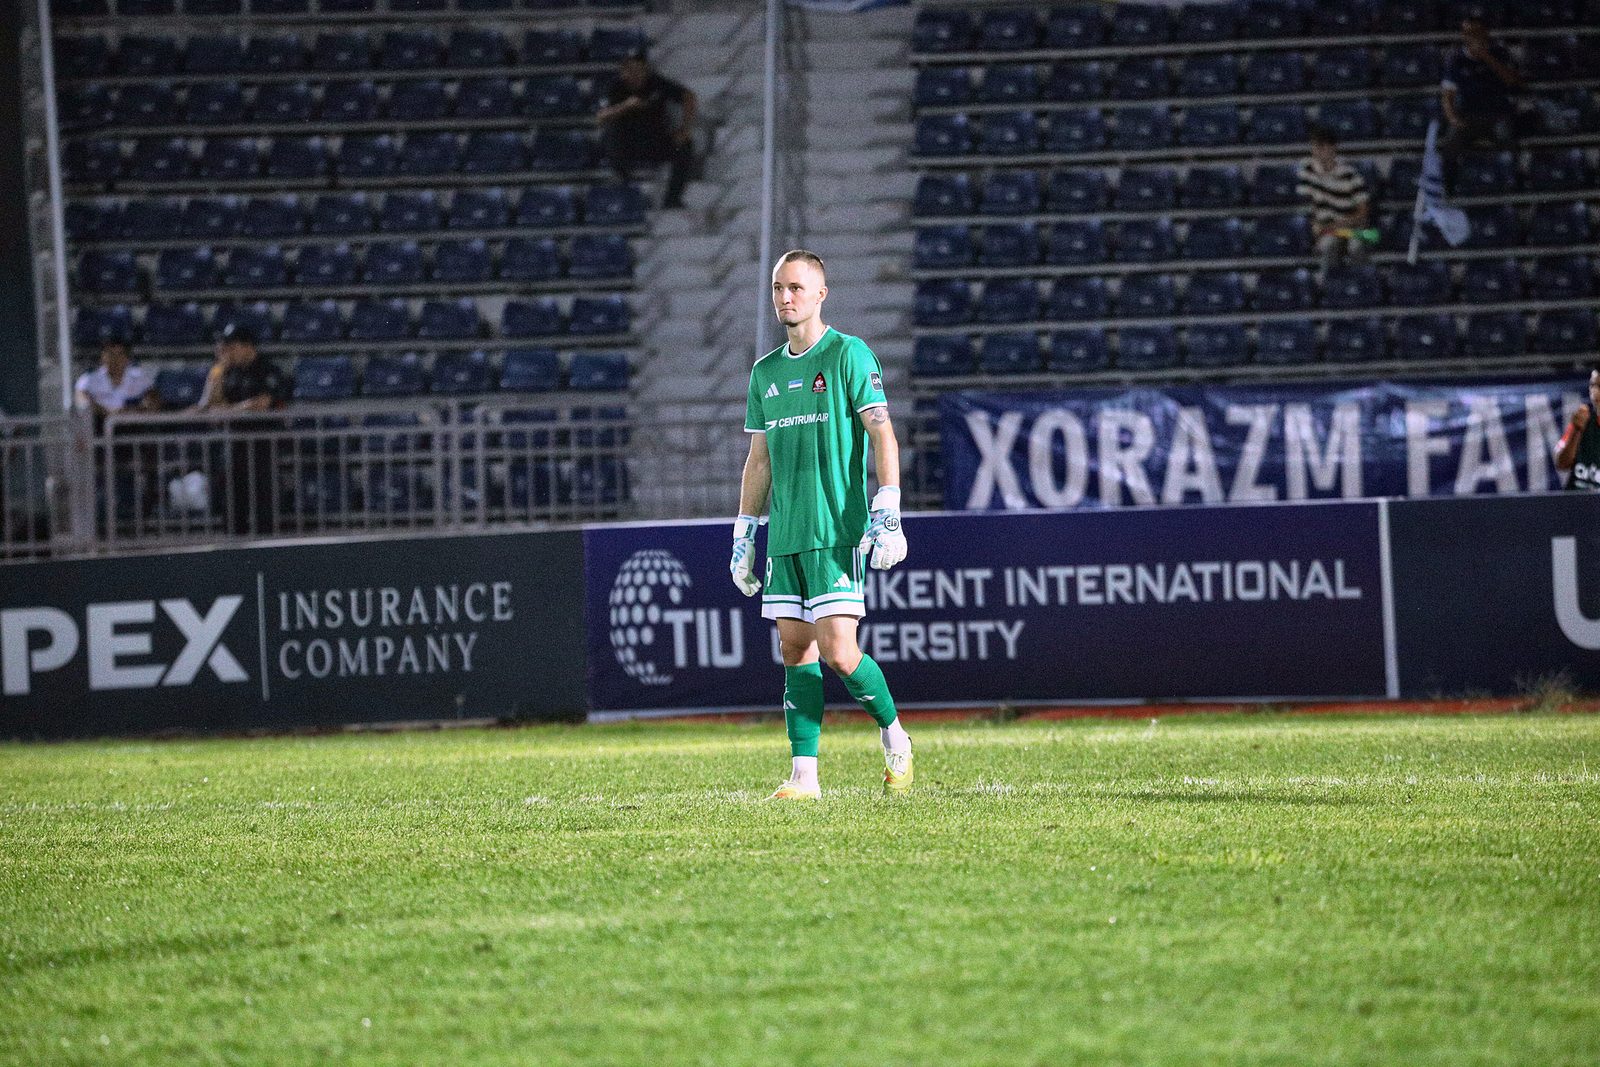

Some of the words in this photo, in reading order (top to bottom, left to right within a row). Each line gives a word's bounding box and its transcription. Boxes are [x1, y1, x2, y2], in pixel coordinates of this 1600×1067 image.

[966, 401, 1363, 510] XORAZM
[279, 581, 513, 631] INSURANCE
[864, 568, 993, 609] HKENT
[1004, 558, 1362, 607] INTERNATIONAL
[0, 595, 249, 695] PEX
[279, 632, 479, 680] COMPANY
[662, 608, 744, 668] TIU
[771, 620, 1024, 664] ERSITY
